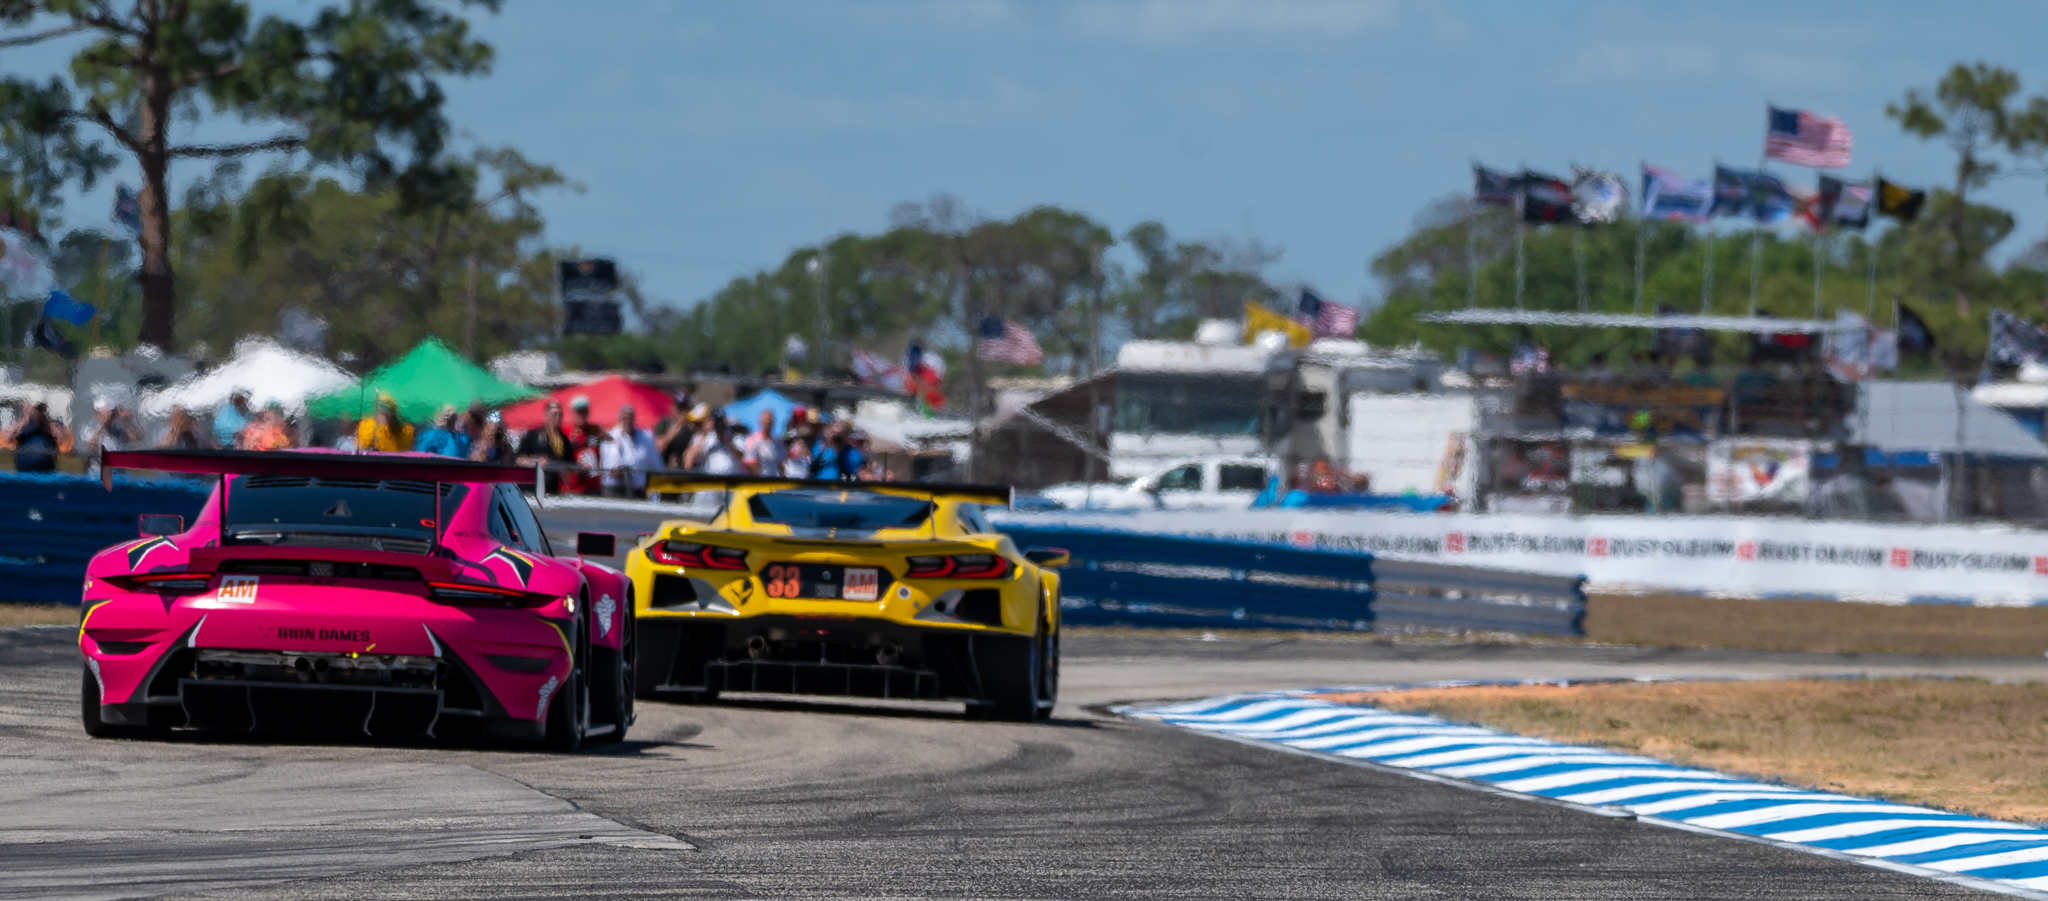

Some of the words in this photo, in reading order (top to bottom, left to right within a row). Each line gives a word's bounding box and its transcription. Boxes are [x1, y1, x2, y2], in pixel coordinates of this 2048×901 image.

[219, 579, 256, 598] AM
[767, 565, 800, 598] 33
[844, 573, 876, 595] AM
[278, 626, 316, 640] IRON
[319, 628, 371, 642] DAMES
